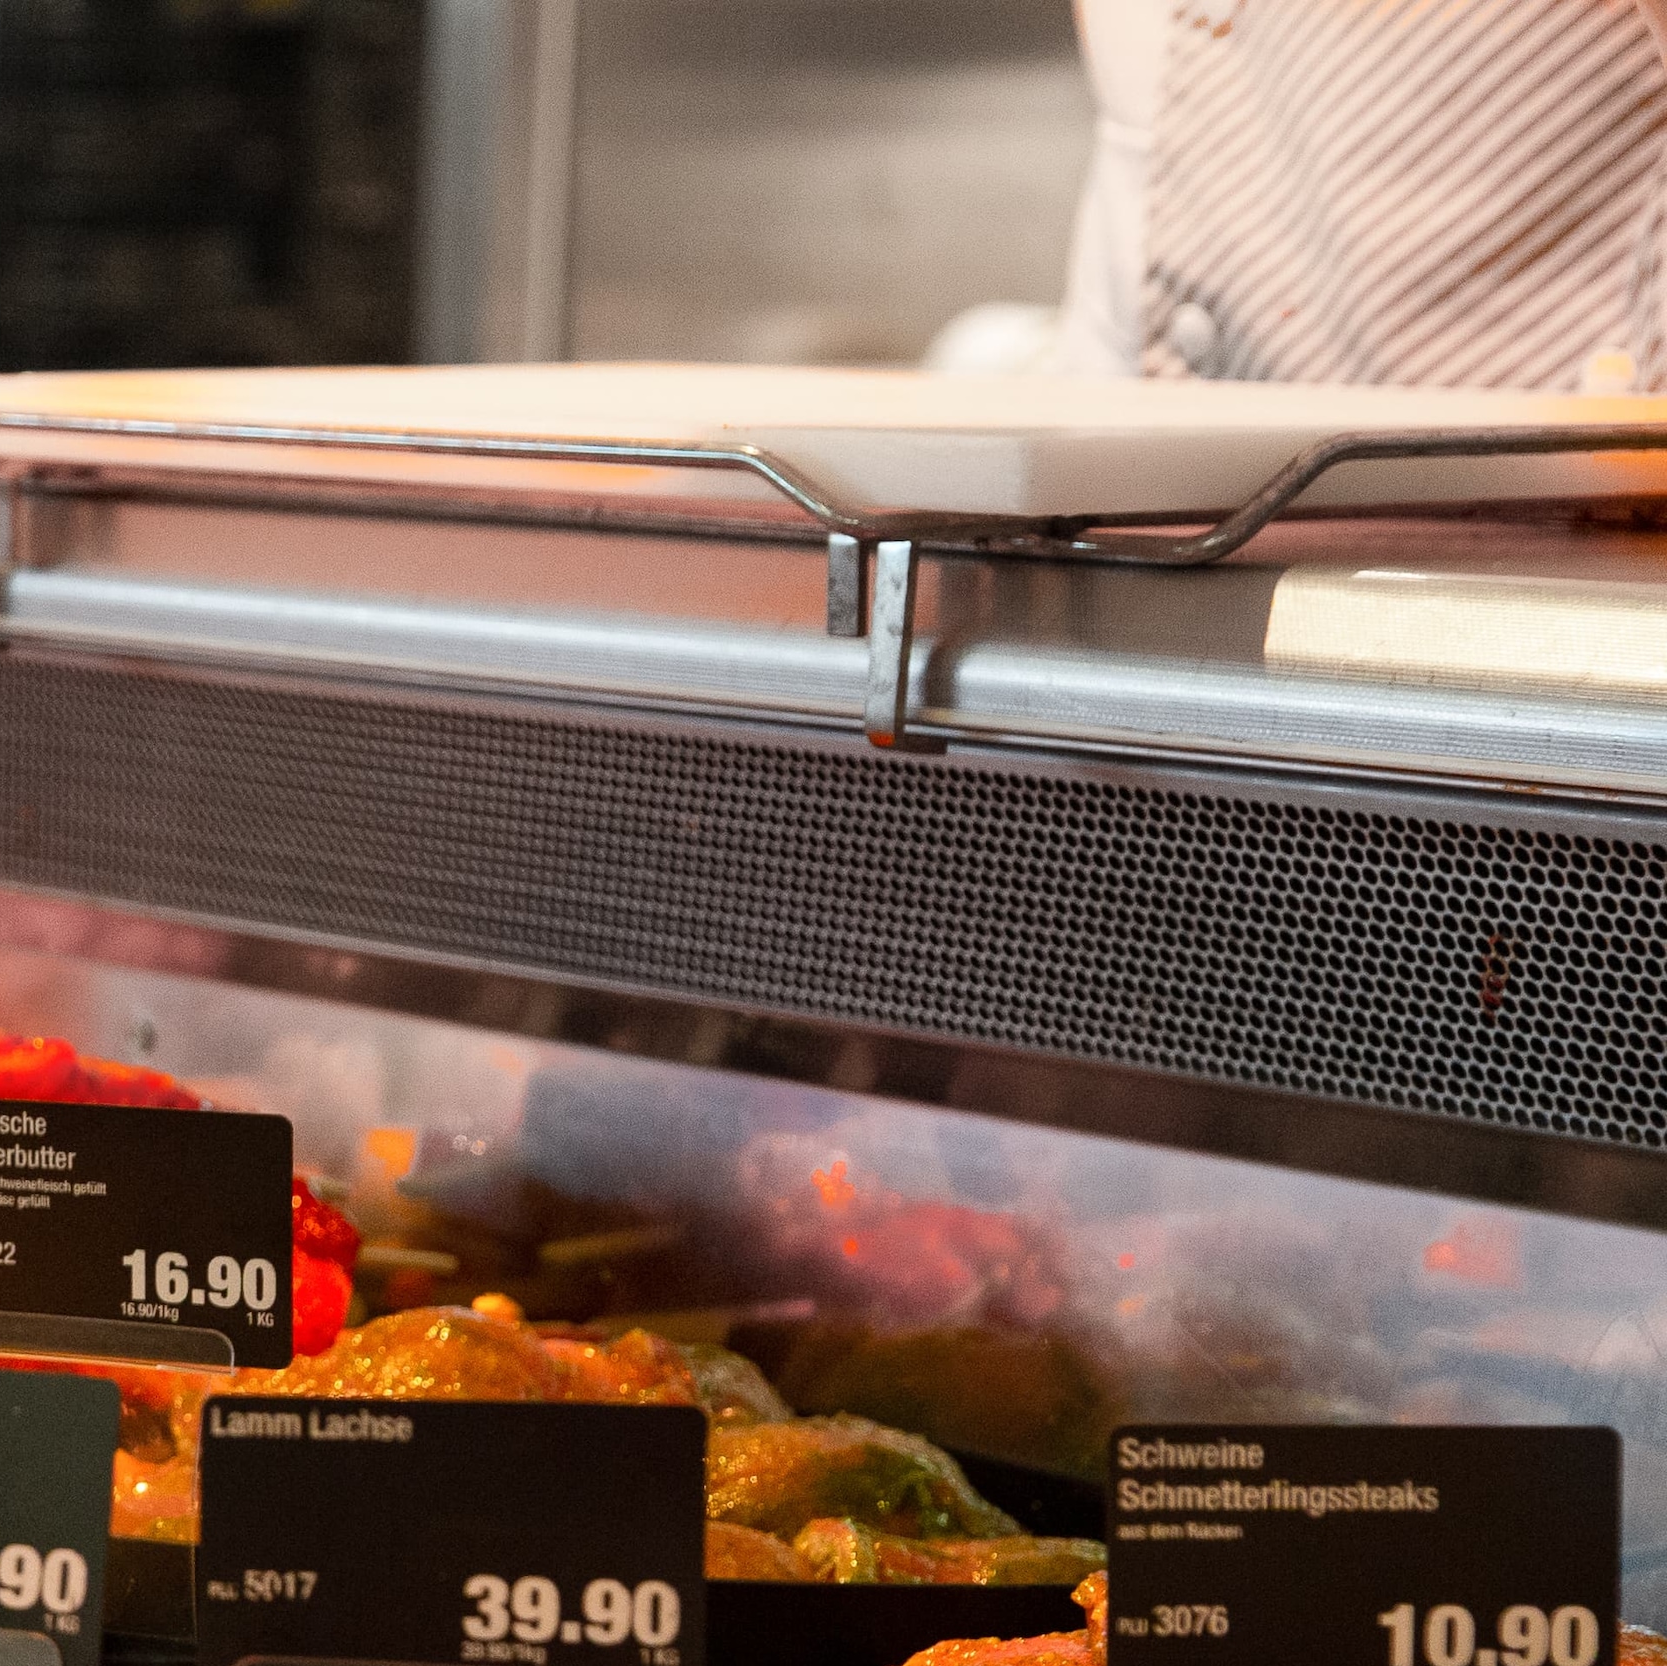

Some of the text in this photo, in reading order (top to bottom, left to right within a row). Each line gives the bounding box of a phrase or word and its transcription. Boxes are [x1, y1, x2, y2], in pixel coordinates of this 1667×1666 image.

[17, 1195, 50, 1210] gefüllt
[73, 1181, 107, 1197] gefüllt
[123, 1248, 277, 1310] 16.90
[120, 1302, 274, 1327] 16.90/1kg 1 KG
[210, 1407, 415, 1444] Lamm Lachse
[1117, 1437, 1265, 1470] Schweine
[1117, 1479, 1440, 1518] Schmetterlingssteaks
[244, 1569, 317, 1603] 5017
[462, 1574, 681, 1647] 39.90
[1152, 1604, 1229, 1638] 3076
